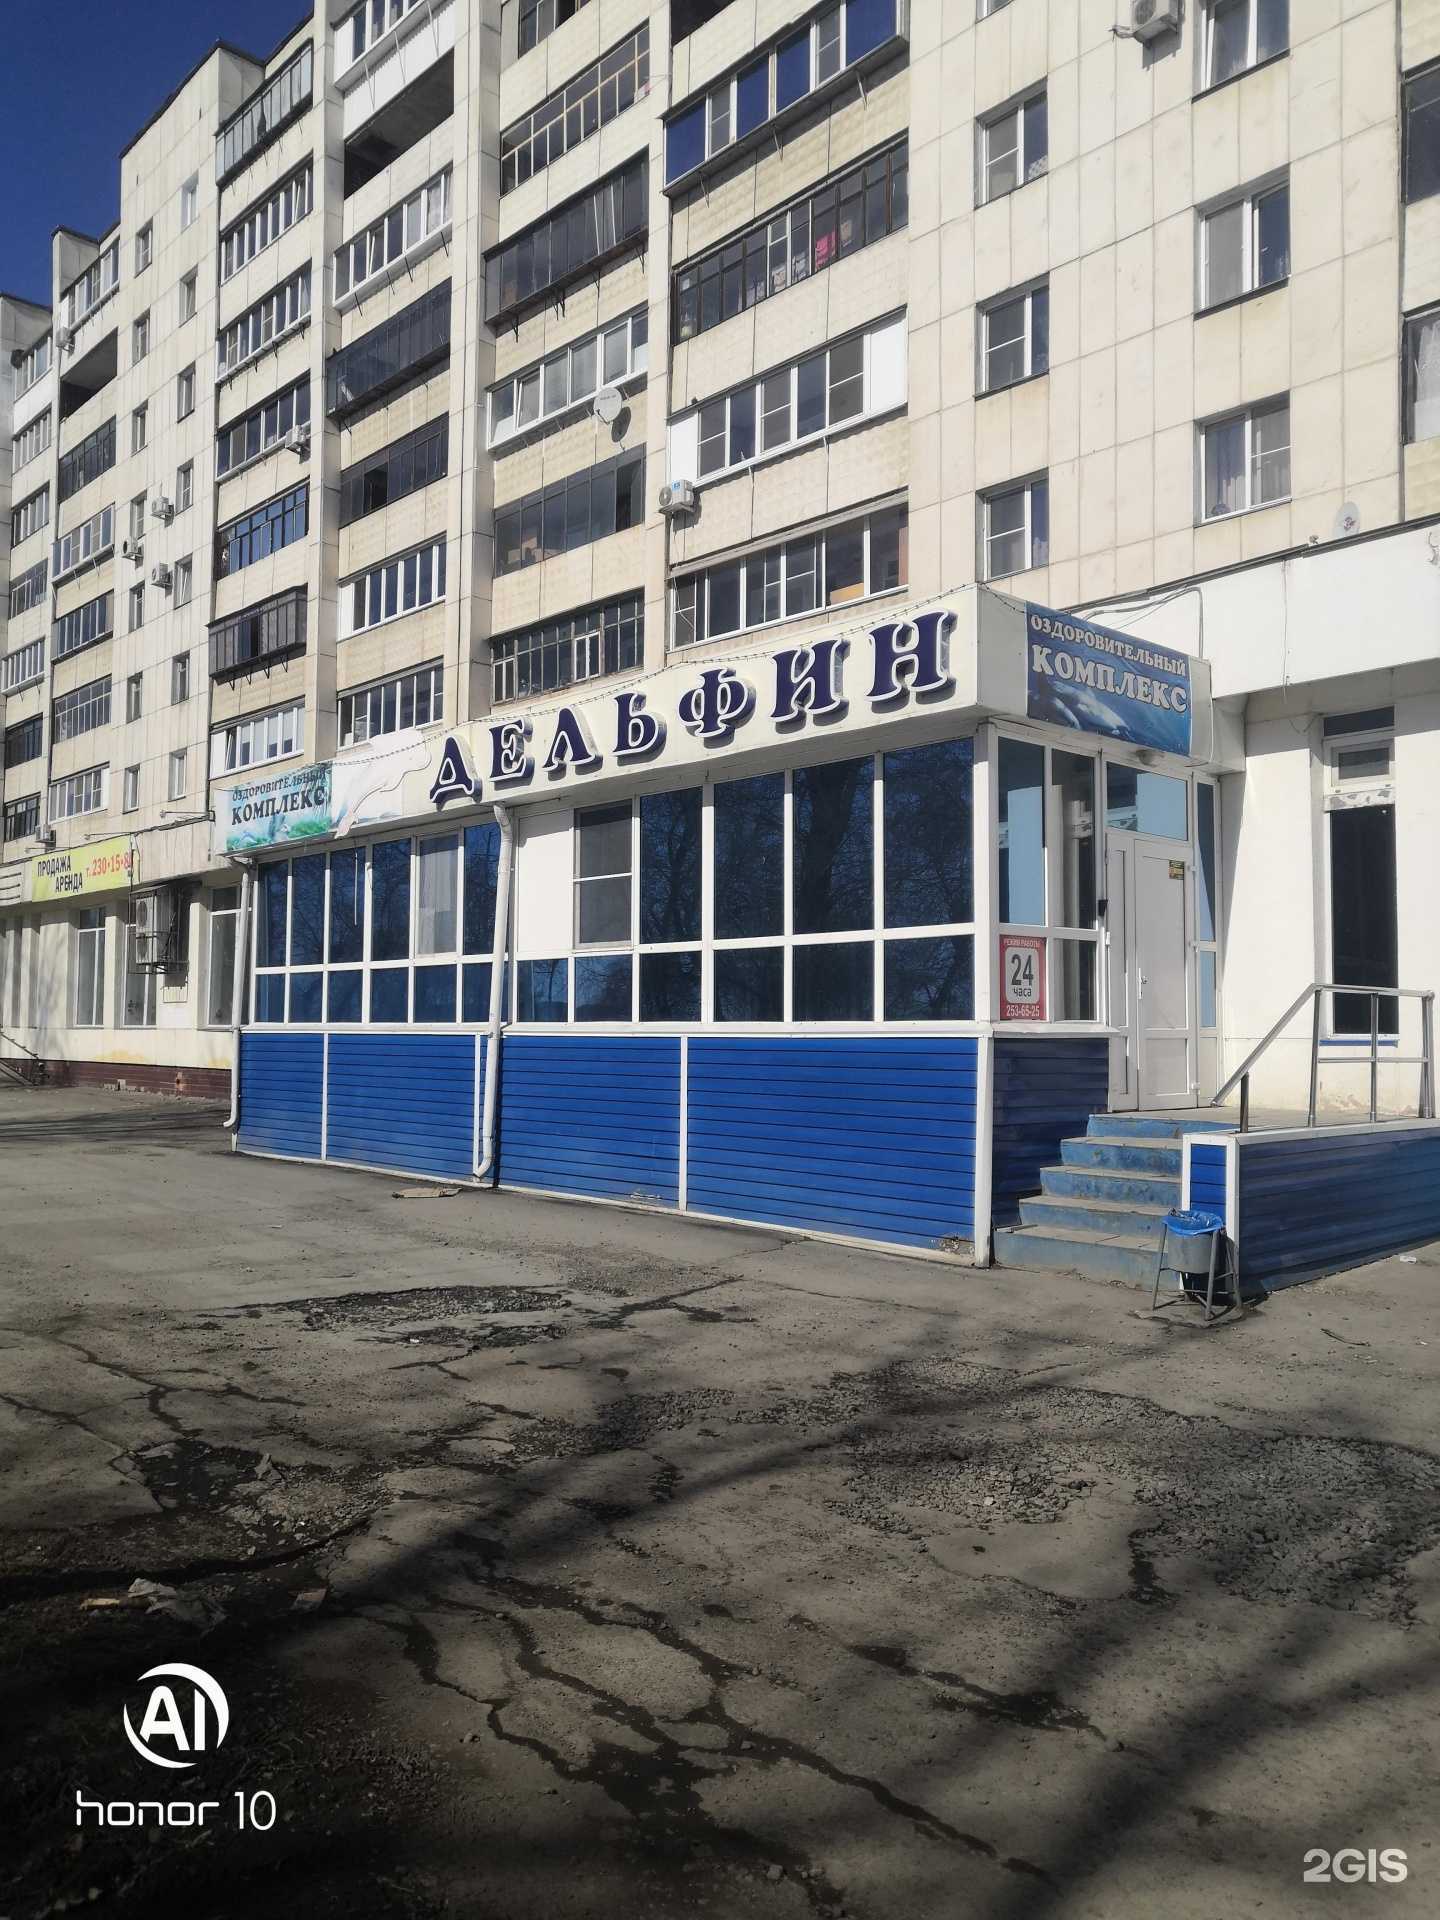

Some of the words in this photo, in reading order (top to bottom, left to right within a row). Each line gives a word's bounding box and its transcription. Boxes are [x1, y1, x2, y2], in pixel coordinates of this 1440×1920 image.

[1030, 614, 1186, 677] ОЗДОРОВИТЕЛЬНЫЙ
[1031, 644, 1188, 713] КОМПЛЕКС
[429, 610, 956, 807] ДЕЛЬФИН
[231, 786, 326, 826] КОМПЛЕКС
[37, 855, 71, 877] ПРОДАЖА
[55, 872, 83, 893] АРЕНДА
[1011, 953, 1034, 986] 24
[1012, 987, 1032, 998] часа
